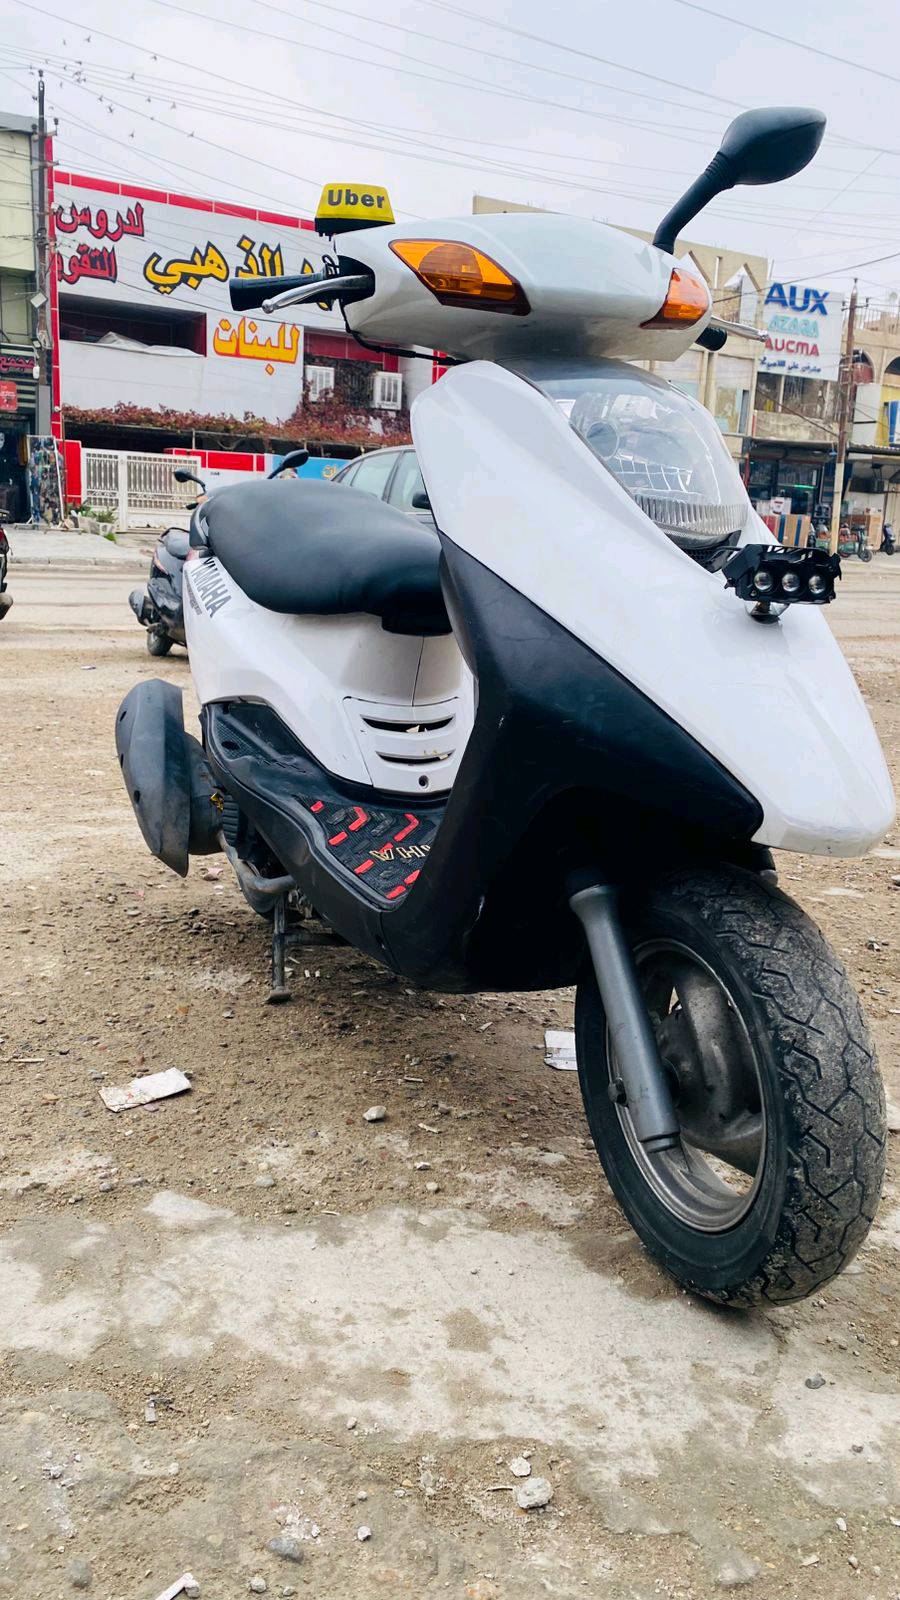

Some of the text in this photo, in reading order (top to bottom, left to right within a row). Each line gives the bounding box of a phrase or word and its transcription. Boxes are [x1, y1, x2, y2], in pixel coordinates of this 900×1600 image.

[326, 187, 387, 210] Uber
[55, 201, 145, 243] لدروس
[764, 283, 829, 316] AUX
[212, 315, 301, 376] للبنات
[764, 336, 820, 357] AUCMA
[190, 556, 232, 619] YAMAHA
